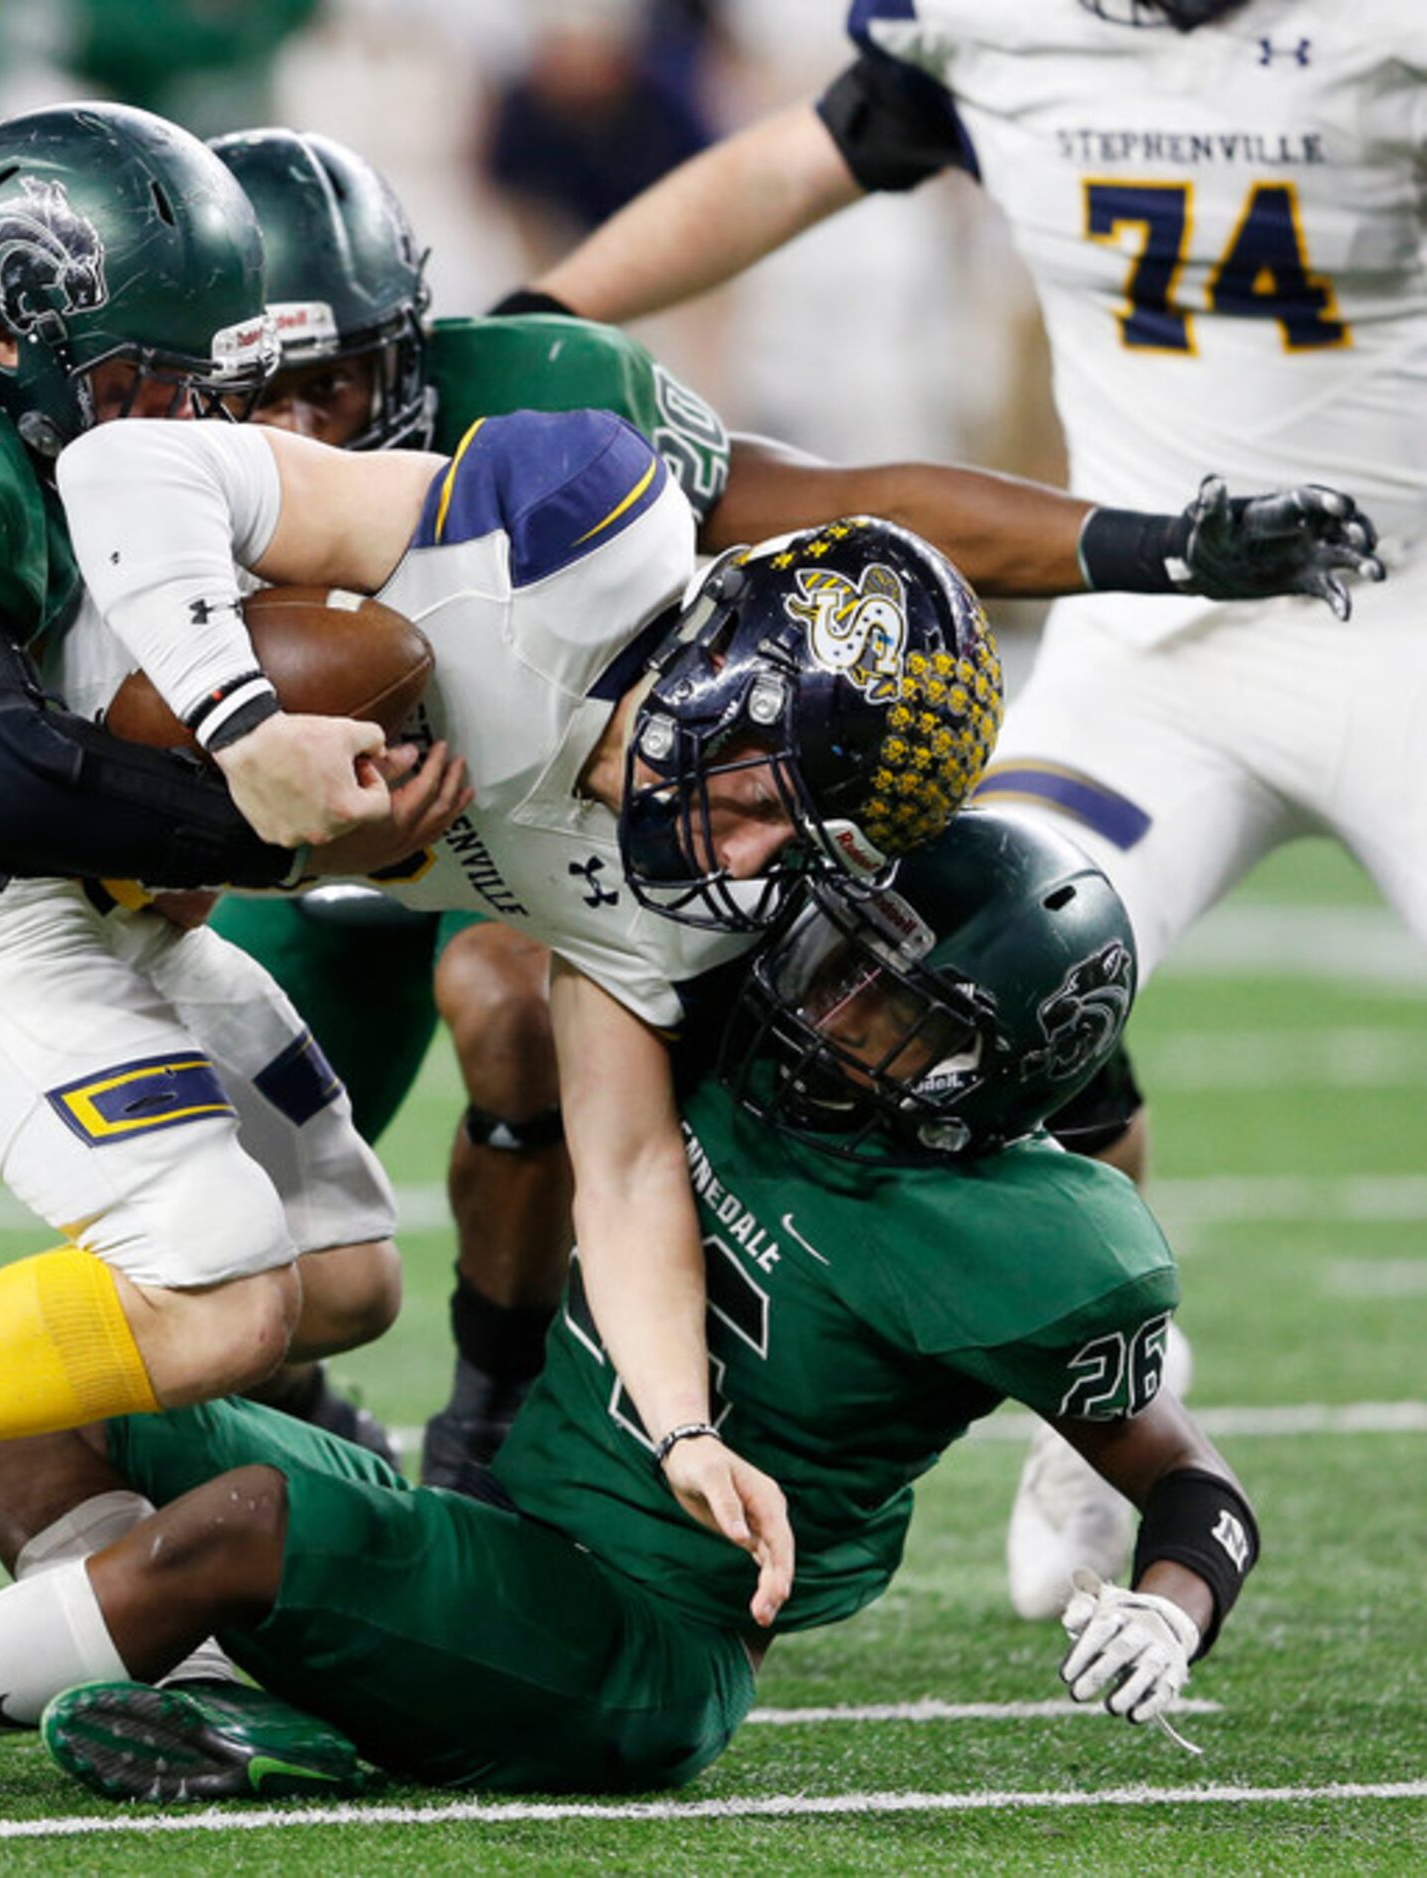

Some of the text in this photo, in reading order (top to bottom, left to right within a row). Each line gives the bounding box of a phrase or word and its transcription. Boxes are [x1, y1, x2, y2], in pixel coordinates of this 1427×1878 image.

[1058, 130, 1325, 164] STEPHENVILLE
[1081, 177, 1354, 357] 74
[1057, 1309, 1172, 1422] 26
